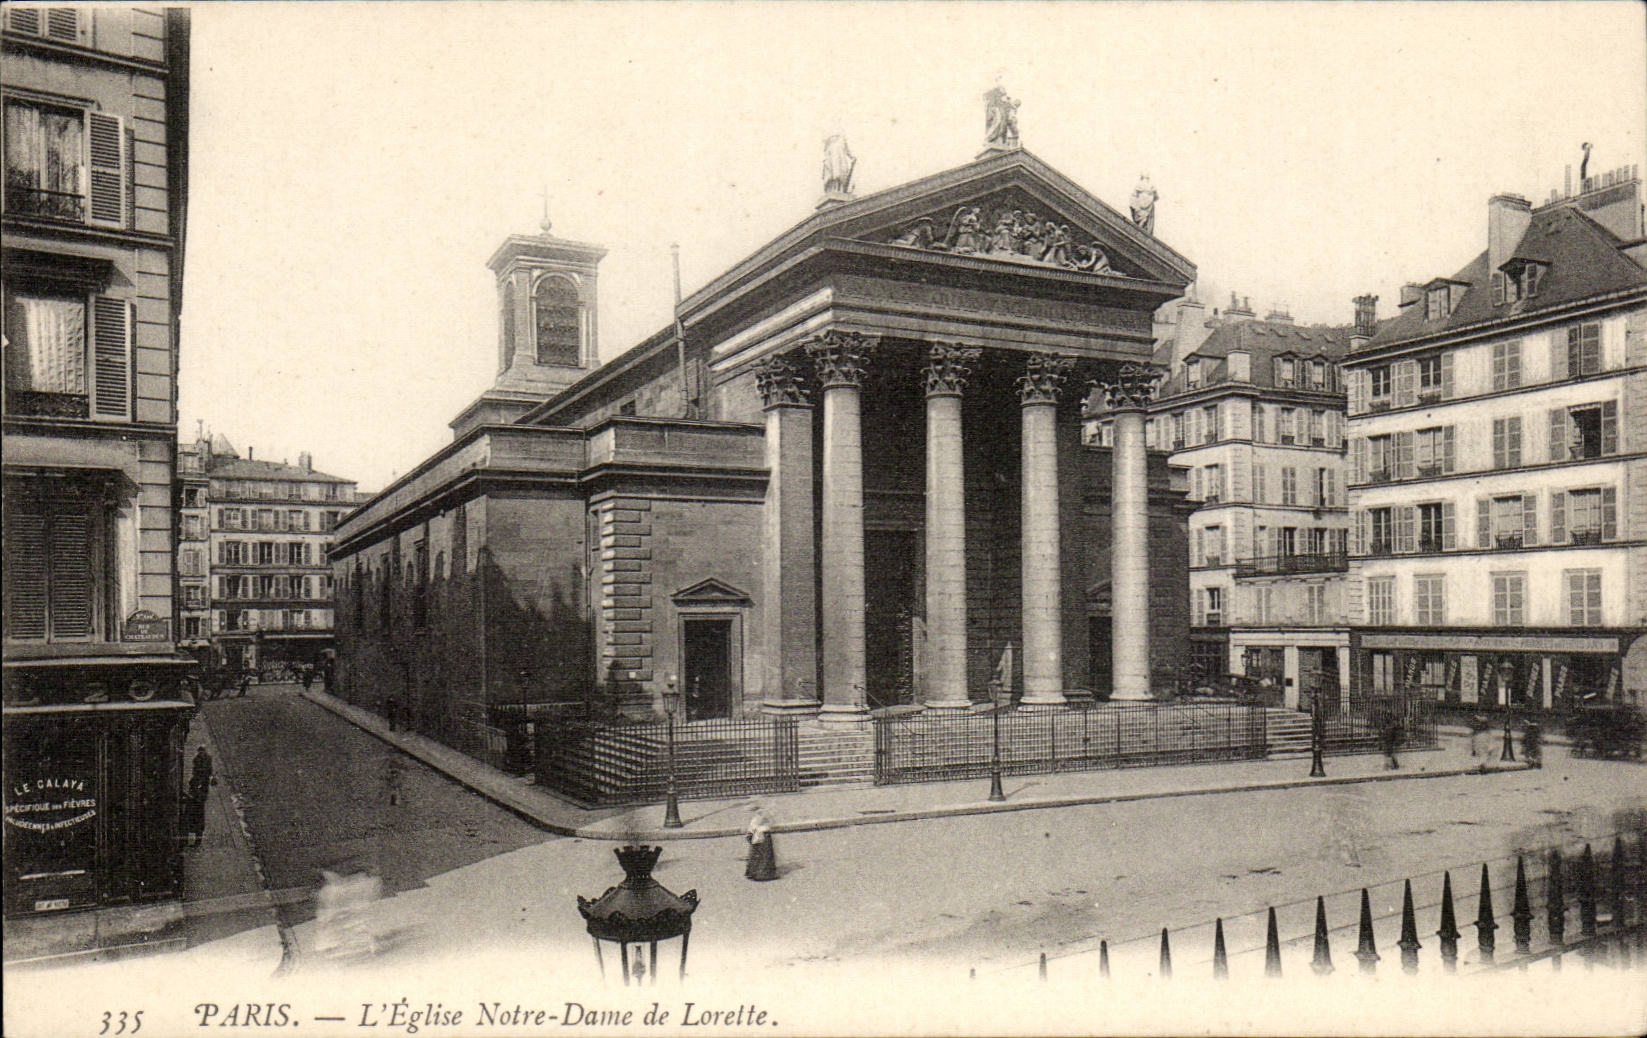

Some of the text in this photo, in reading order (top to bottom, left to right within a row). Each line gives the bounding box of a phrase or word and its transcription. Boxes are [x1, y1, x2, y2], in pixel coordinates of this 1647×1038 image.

[14, 778, 84, 796] LE CALAYA
[63, 798, 96, 809] FIÈVRES
